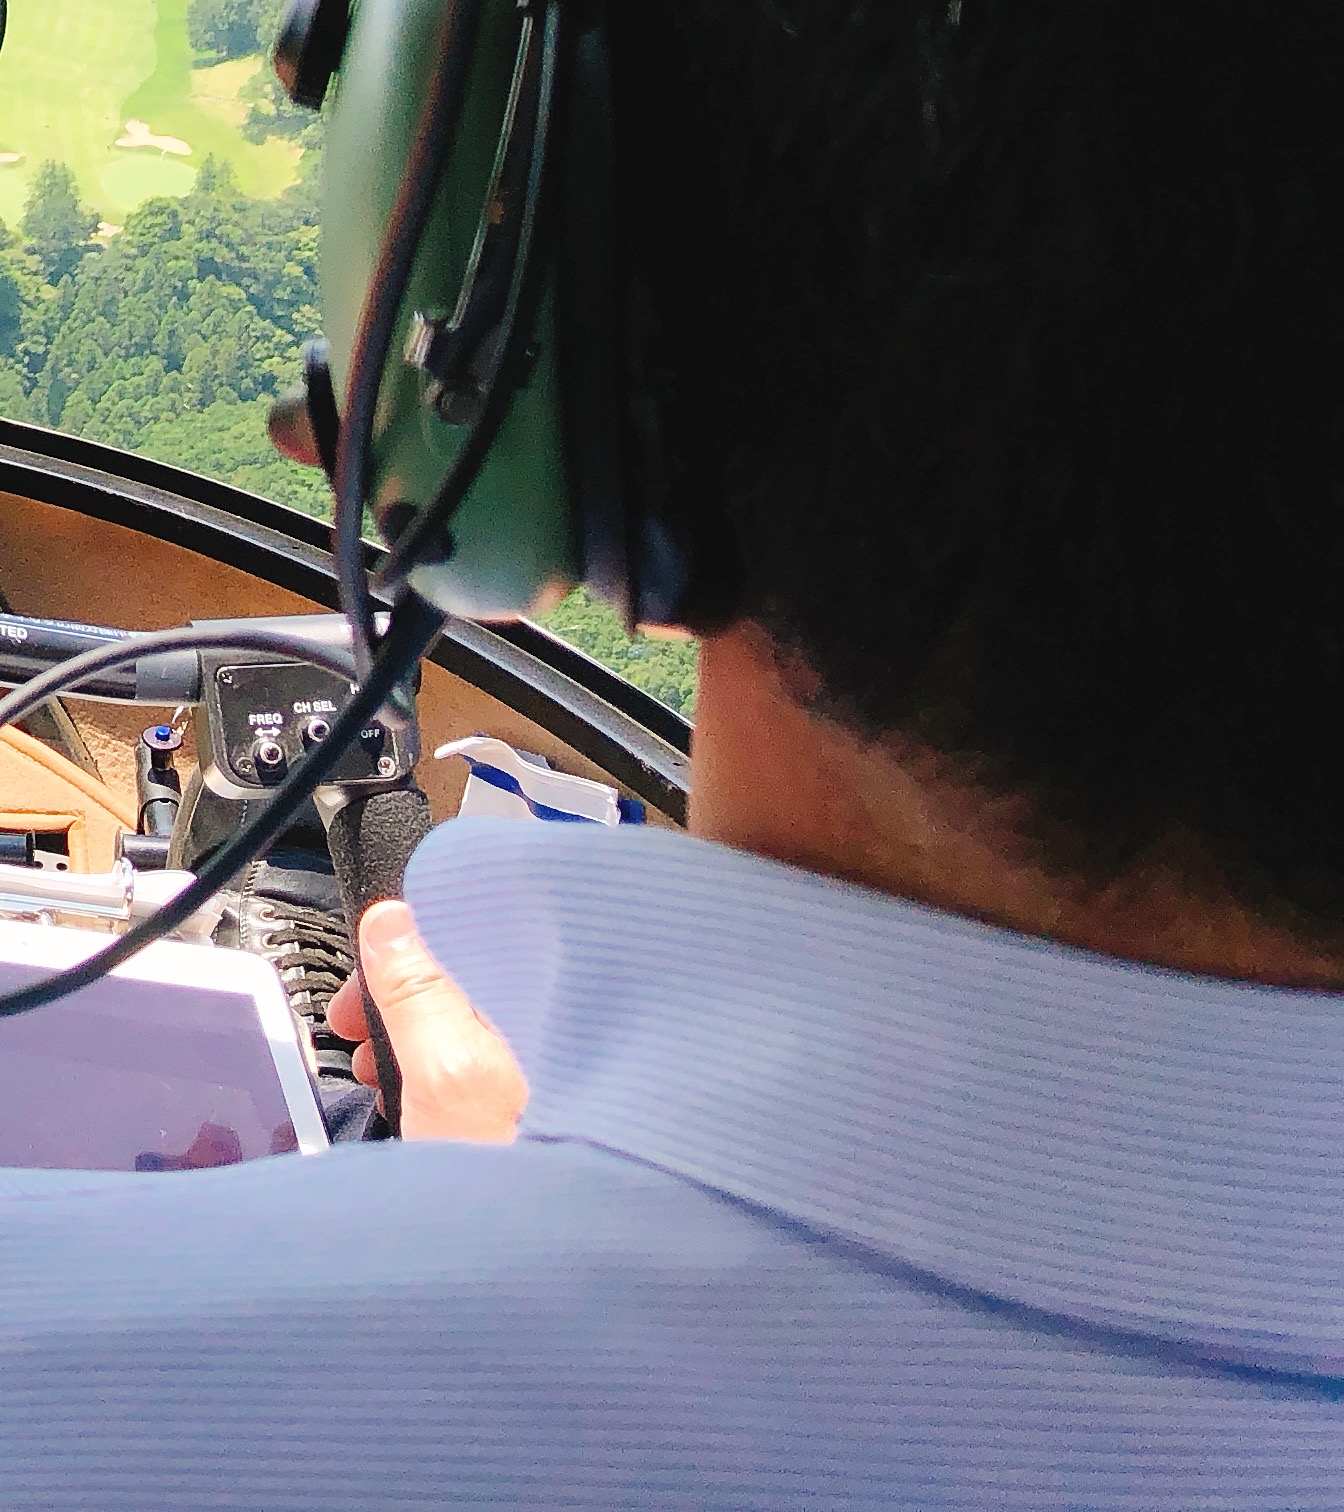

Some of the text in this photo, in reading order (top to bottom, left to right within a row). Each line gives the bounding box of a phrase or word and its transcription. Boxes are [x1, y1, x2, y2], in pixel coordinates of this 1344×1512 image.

[293, 700, 337, 713] CH SEL
[248, 713, 283, 726] FREQ
[361, 729, 380, 739] OFF
